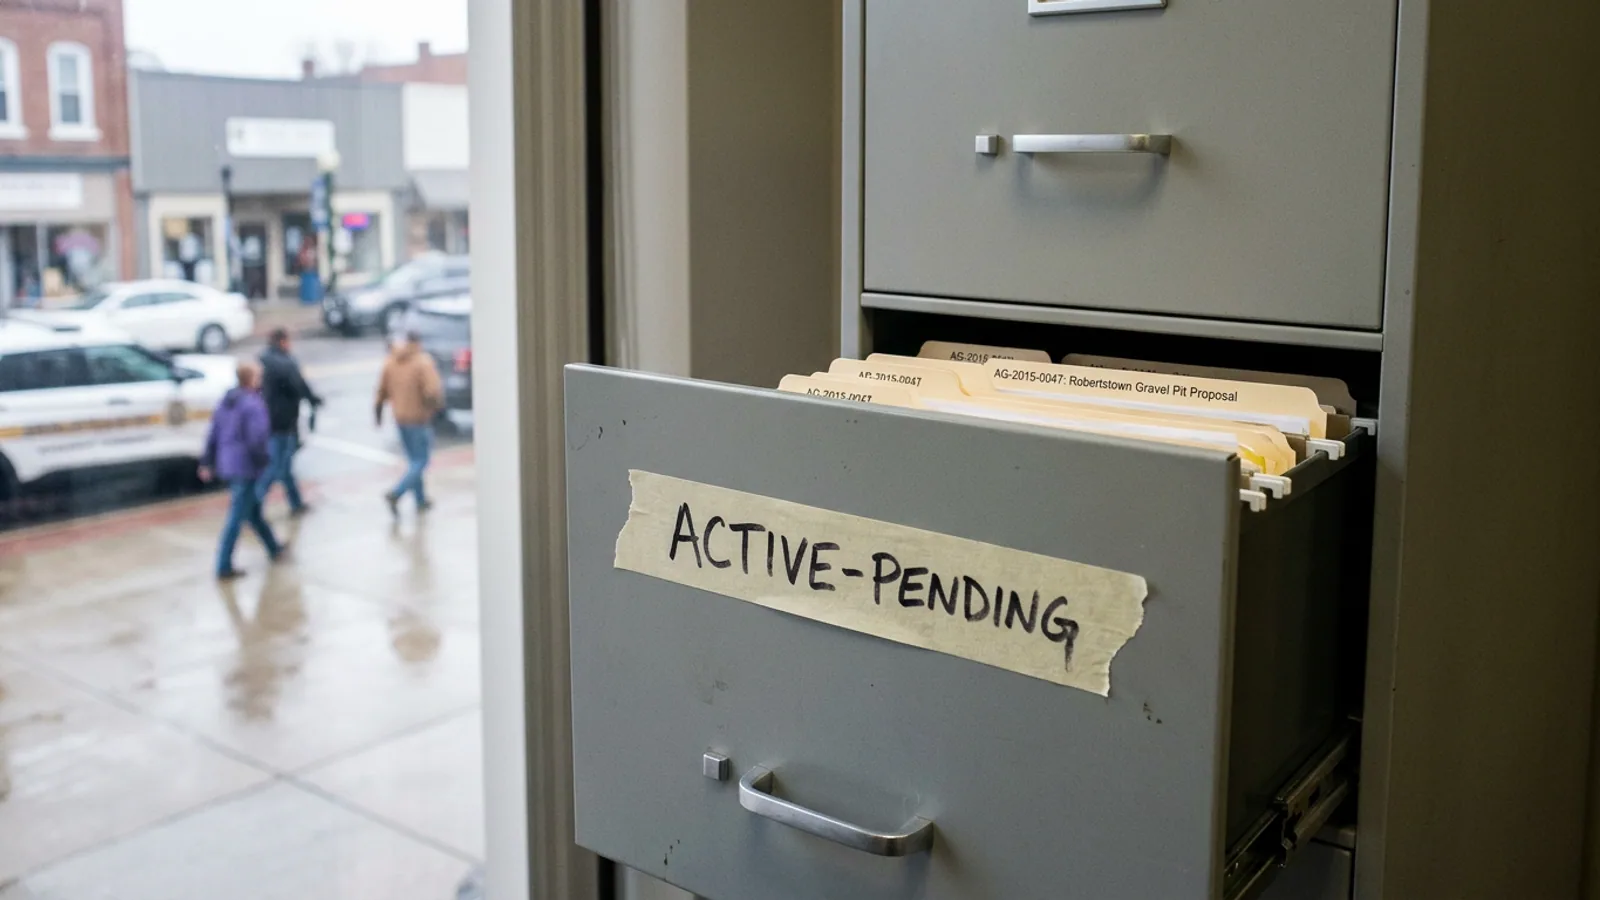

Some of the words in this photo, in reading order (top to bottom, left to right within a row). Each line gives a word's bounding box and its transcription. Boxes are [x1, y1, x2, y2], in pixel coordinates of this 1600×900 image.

[993, 368, 1066, 385] AG-2015-0047:
[1069, 376, 1132, 392] Robertstown
[1135, 381, 1170, 395] Gravel
[1172, 385, 1187, 397] Pit
[1190, 386, 1238, 402] Proposal
[669, 502, 1080, 672] ACTIVE-PENDING
